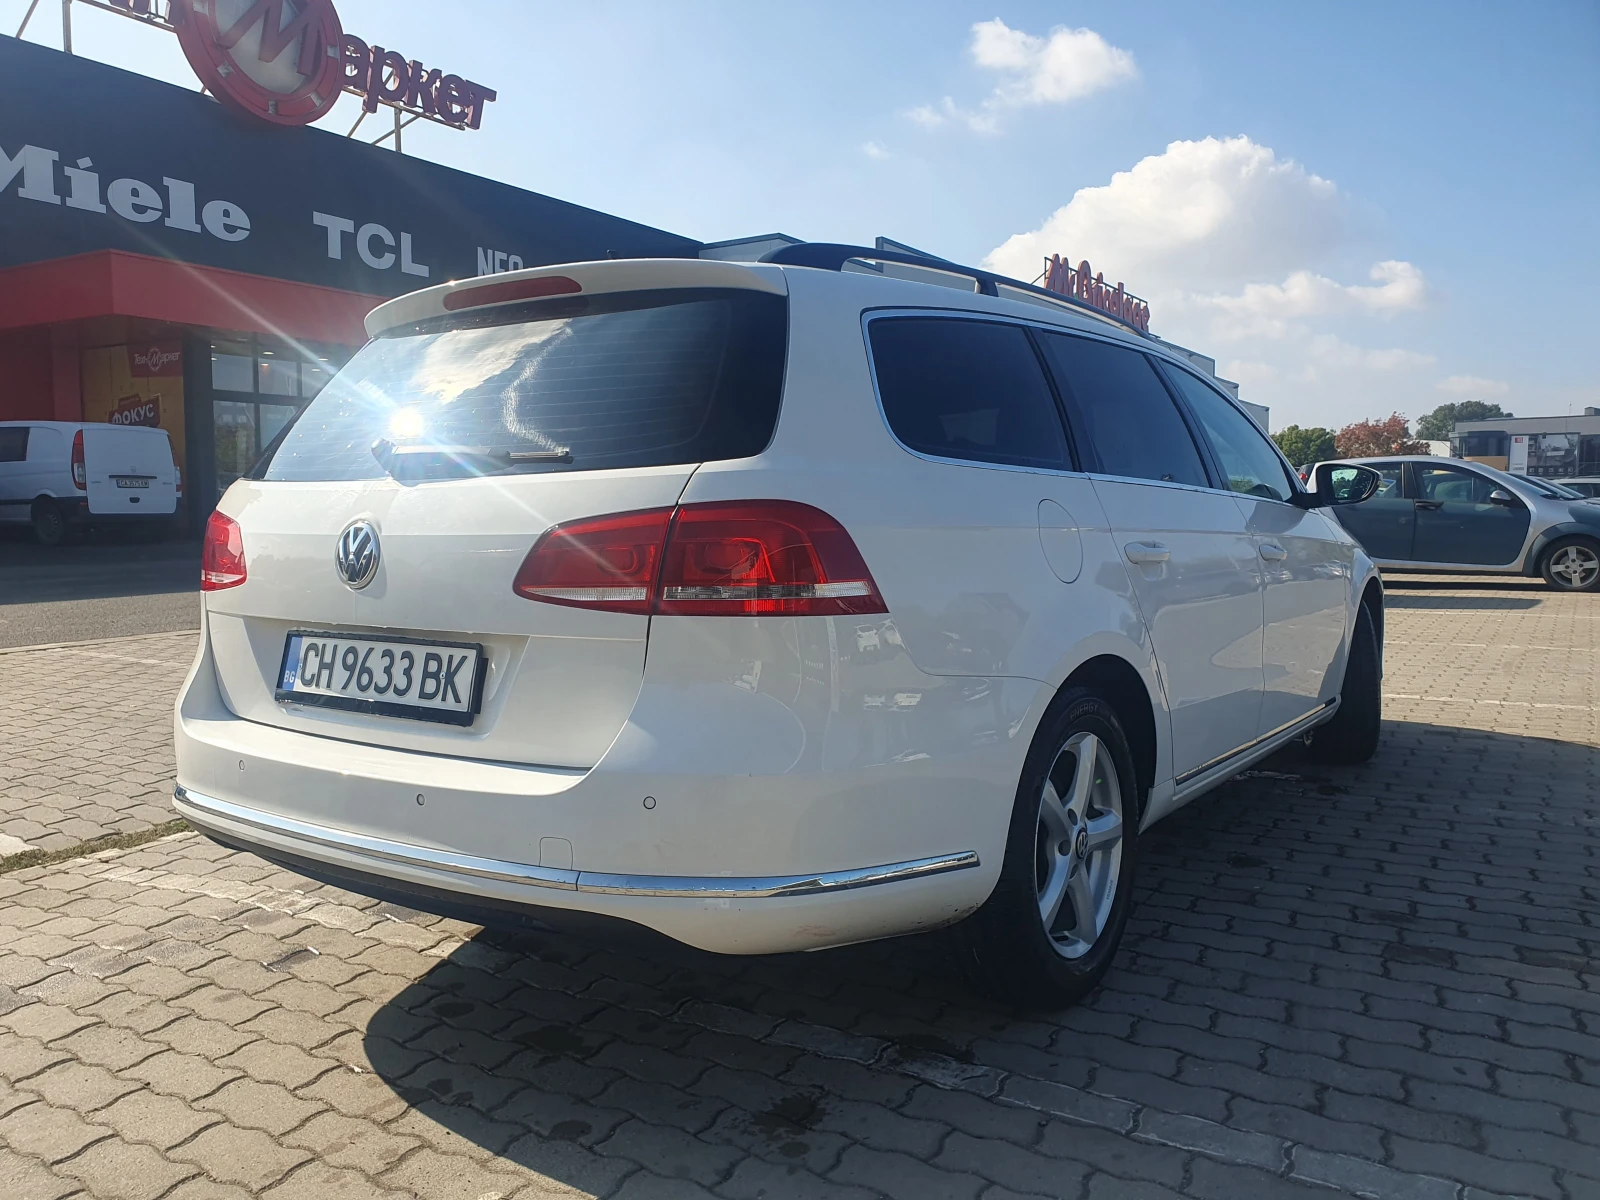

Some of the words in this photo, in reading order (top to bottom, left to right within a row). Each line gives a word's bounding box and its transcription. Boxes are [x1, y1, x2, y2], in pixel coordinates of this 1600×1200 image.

[0, 143, 251, 242] Miele
[312, 210, 430, 278] TCL
[284, 670, 295, 683] BG
[301, 642, 339, 690] CH
[340, 645, 415, 698] 9633
[418, 652, 468, 704] BK
